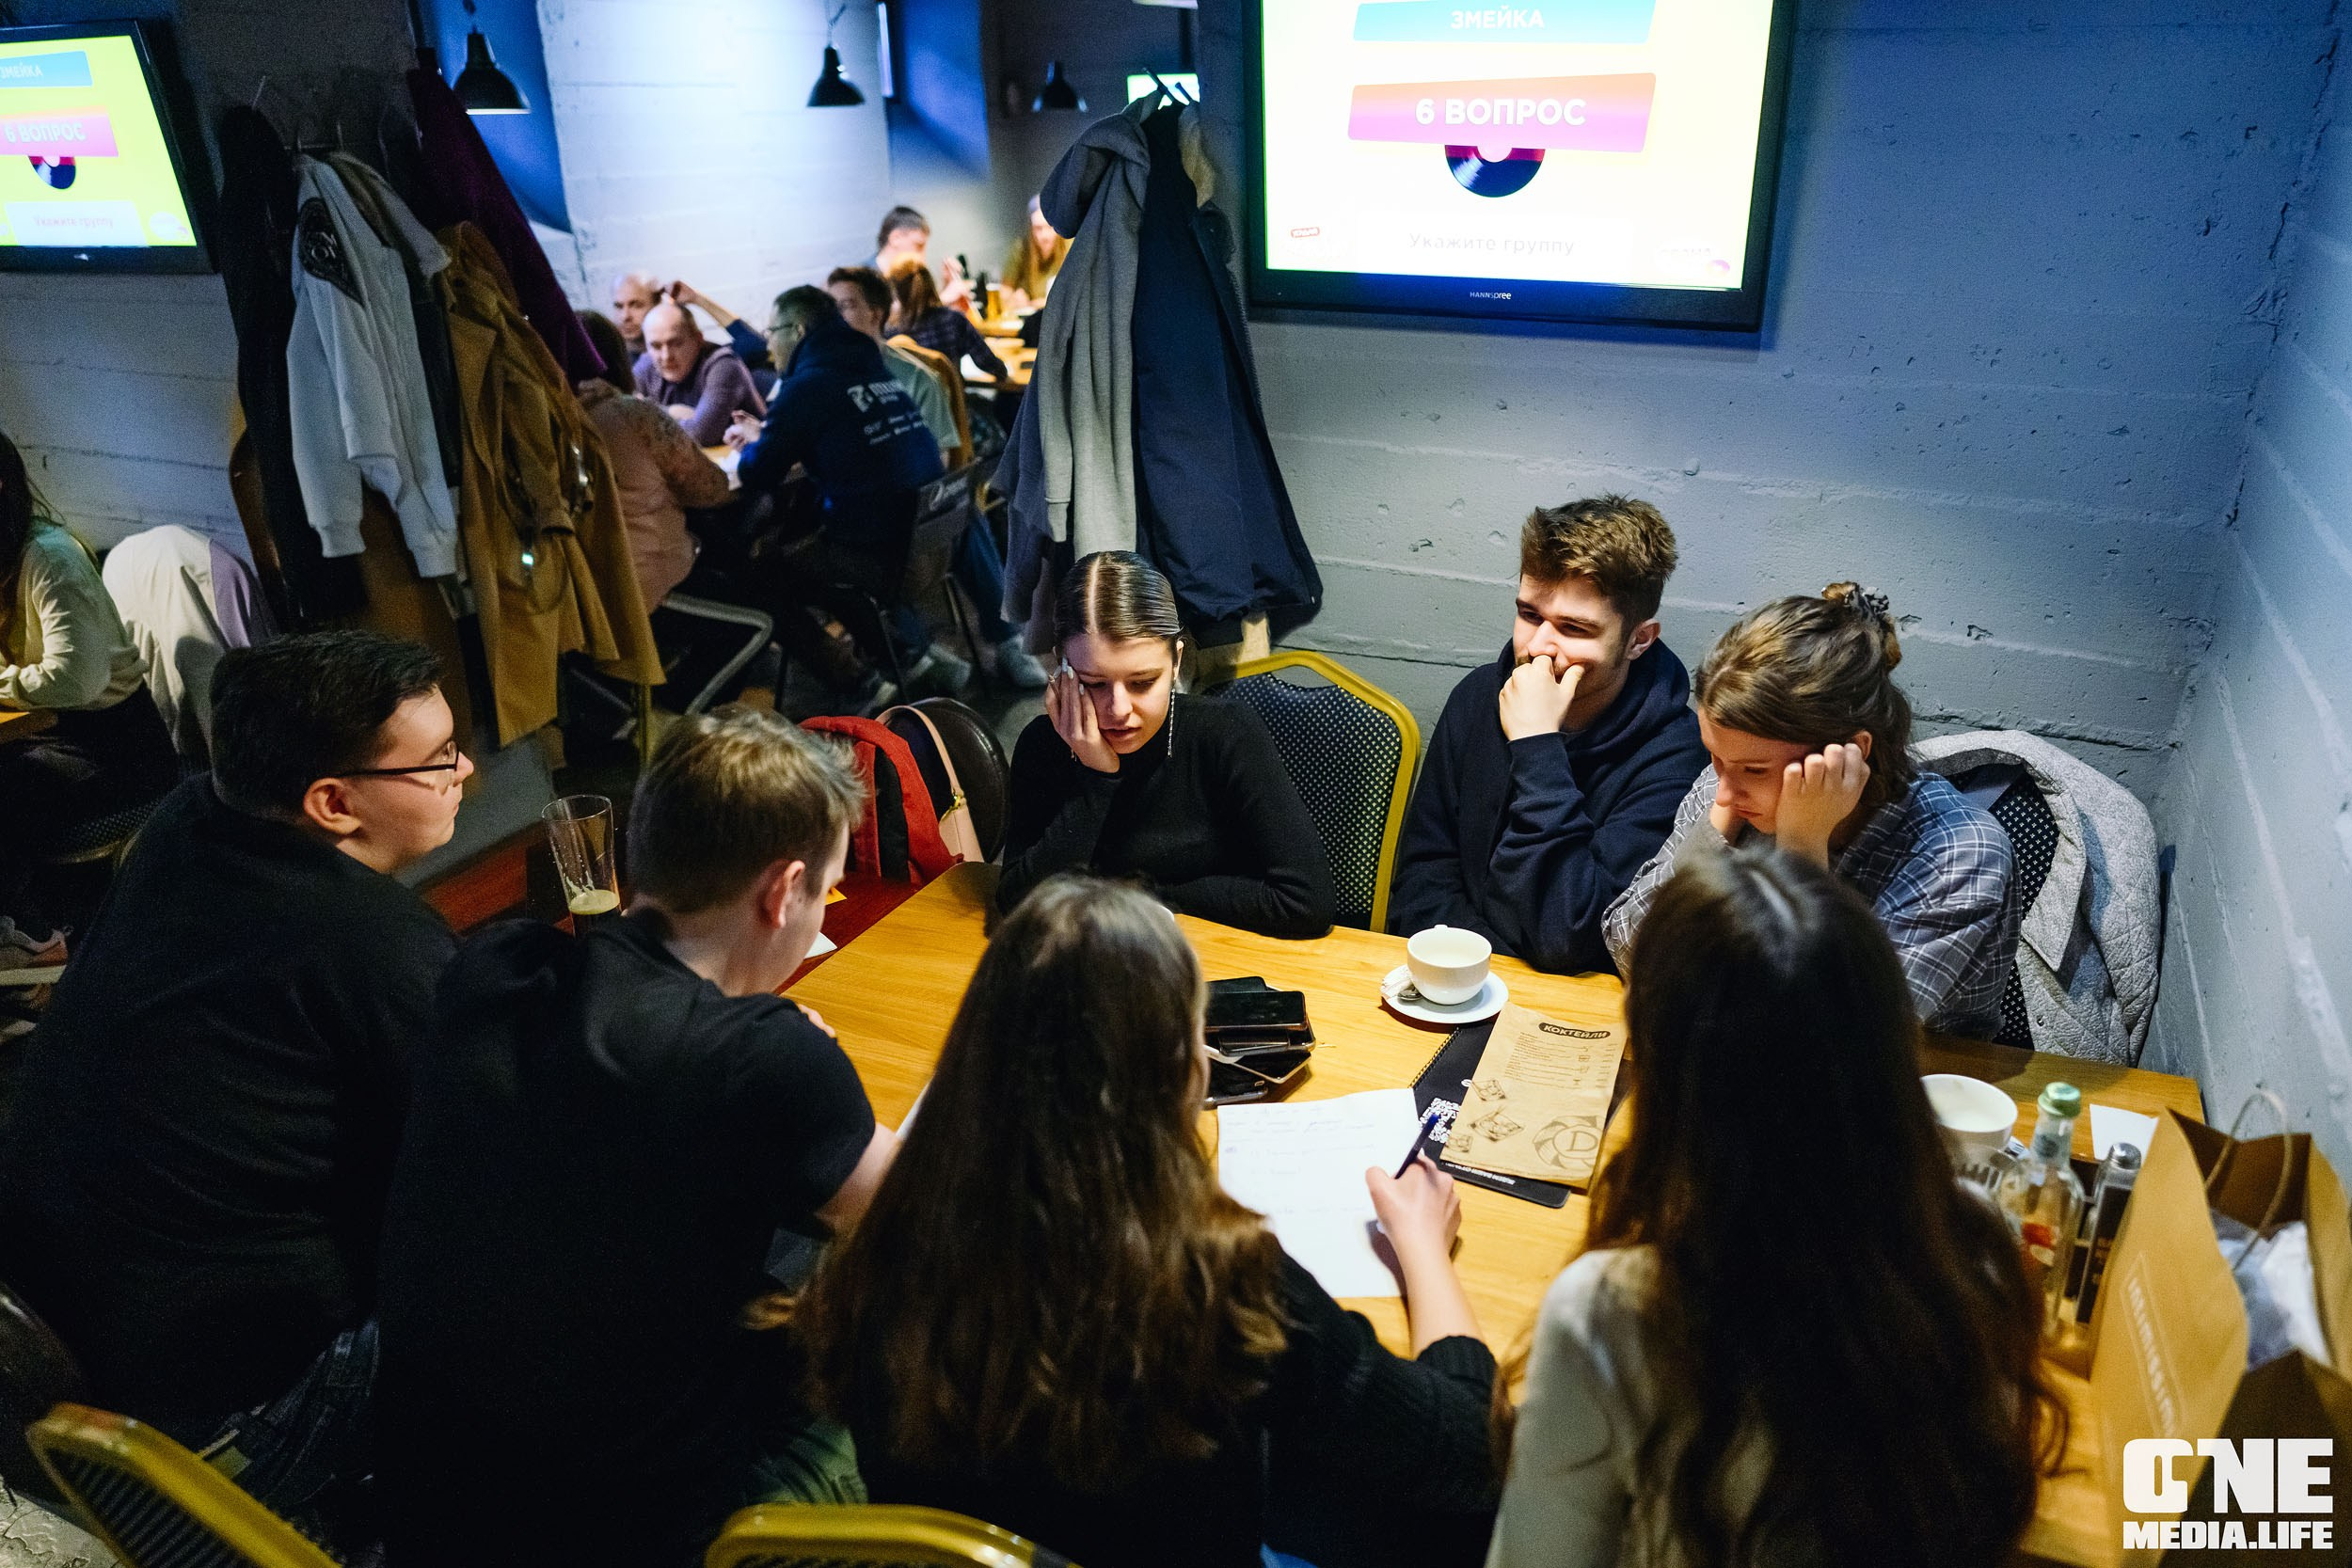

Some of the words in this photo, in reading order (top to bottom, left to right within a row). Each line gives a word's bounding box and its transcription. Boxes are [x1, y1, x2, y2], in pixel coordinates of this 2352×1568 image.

[1450, 5, 1545, 29] ЗМЕЙКА
[1415, 98, 1436, 125] 6
[1445, 98, 1587, 126] ВОПРОС
[5, 124, 16, 143] 6
[18, 122, 87, 142] ВОПРОС
[1408, 232, 1496, 250] Укажите
[1504, 239, 1574, 256] группу
[1544, 1024, 1608, 1039] КОКТЕЙЛИ
